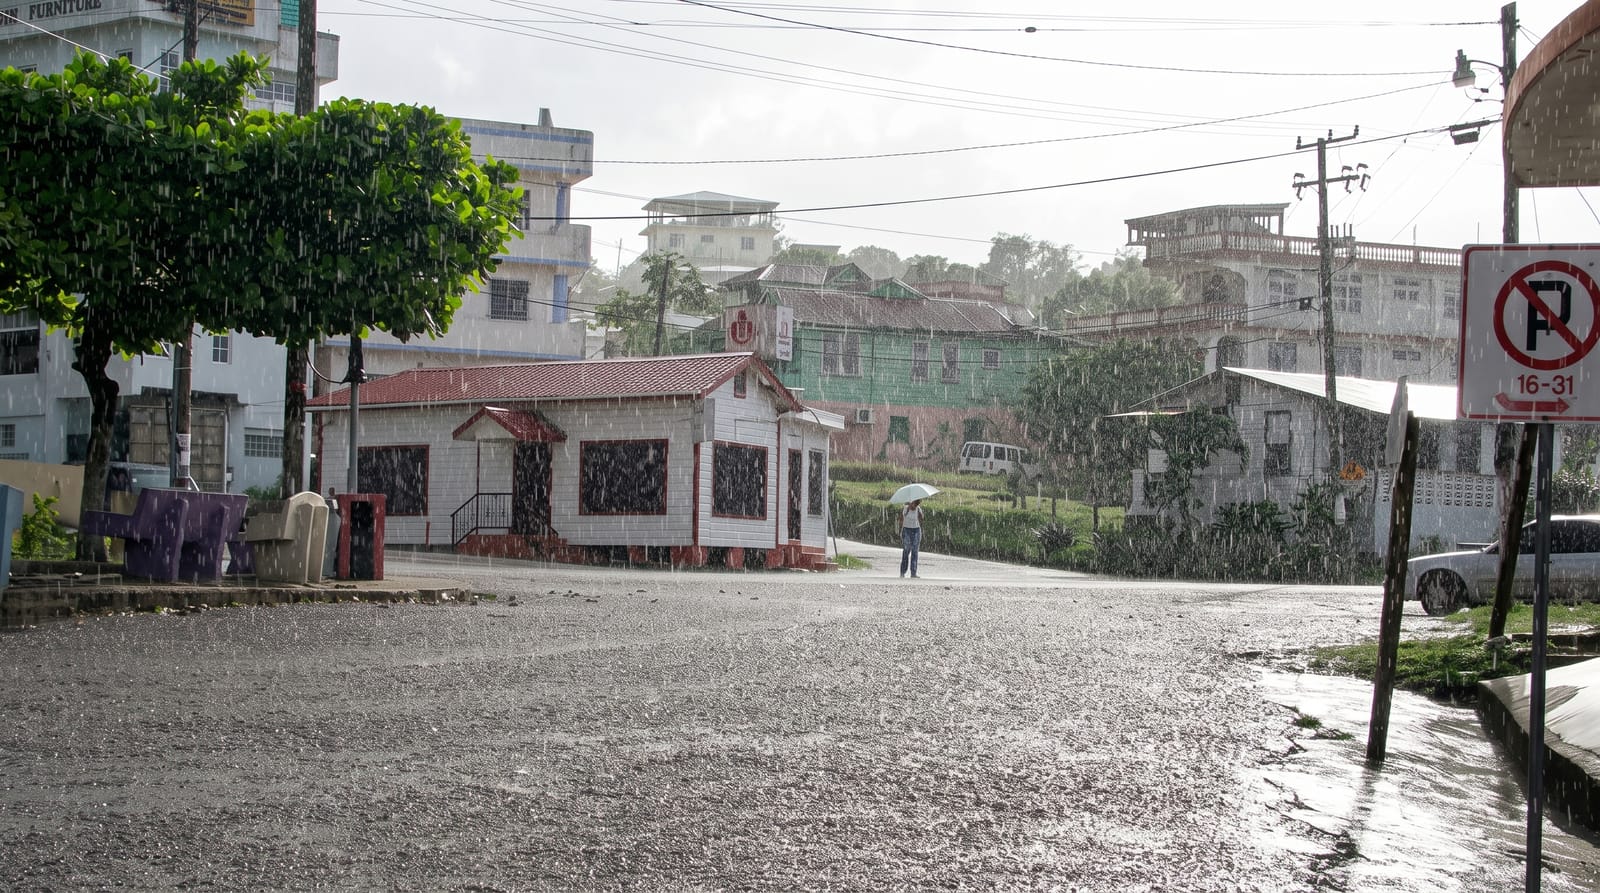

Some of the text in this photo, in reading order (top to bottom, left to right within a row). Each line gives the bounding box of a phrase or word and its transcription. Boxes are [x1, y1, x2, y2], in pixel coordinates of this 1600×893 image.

[29, 0, 102, 20] FURNITURE
[1526, 280, 1571, 351] P
[1517, 374, 1574, 395] 16-31
